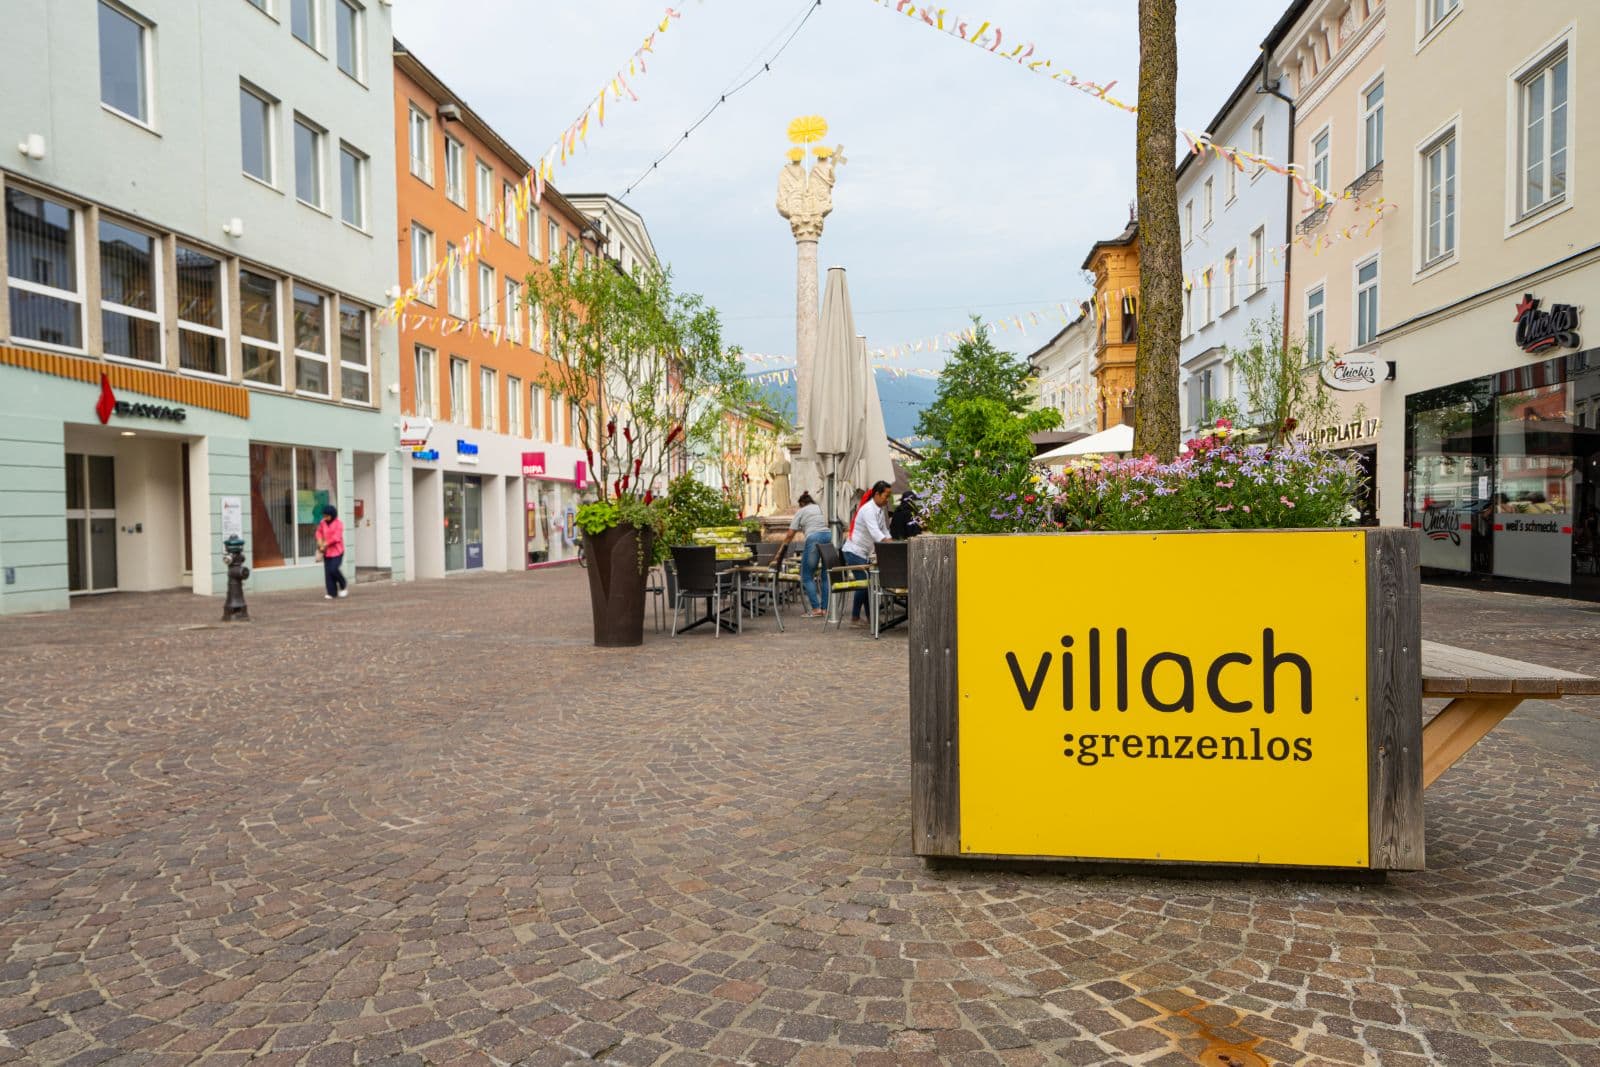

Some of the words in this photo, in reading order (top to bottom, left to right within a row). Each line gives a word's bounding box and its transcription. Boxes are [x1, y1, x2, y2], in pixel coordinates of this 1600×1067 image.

[115, 400, 186, 423] BAWAG
[523, 465, 544, 474] BIPA
[1005, 627, 1312, 715] villach
[1063, 728, 1313, 767] :grenzenlos
